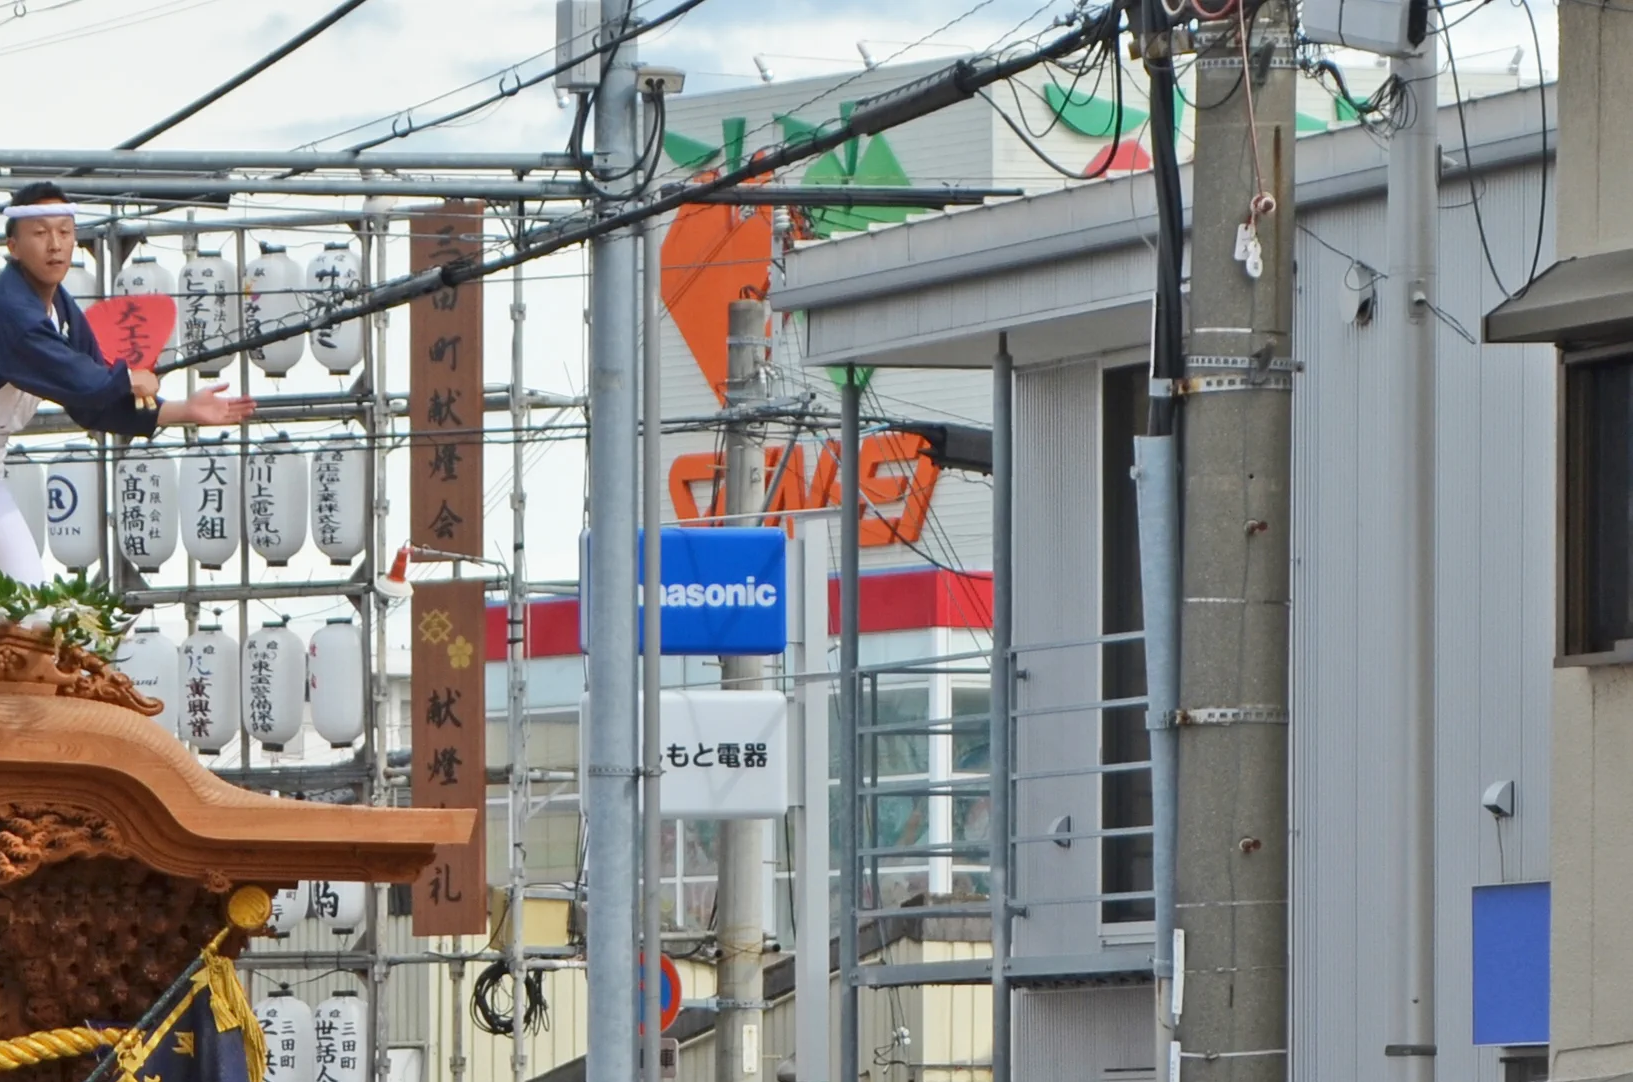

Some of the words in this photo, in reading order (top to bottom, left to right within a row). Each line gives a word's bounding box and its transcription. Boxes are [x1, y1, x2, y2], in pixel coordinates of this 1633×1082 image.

[118, 301, 150, 364] 大工方
[149, 474, 162, 540] 有限会社
[197, 458, 228, 541] 大月組
[658, 743, 768, 769] もと電器
[426, 687, 463, 906] 献燈礼
[279, 1020, 296, 1069] 三田町
[340, 1021, 357, 1070] 三田町
